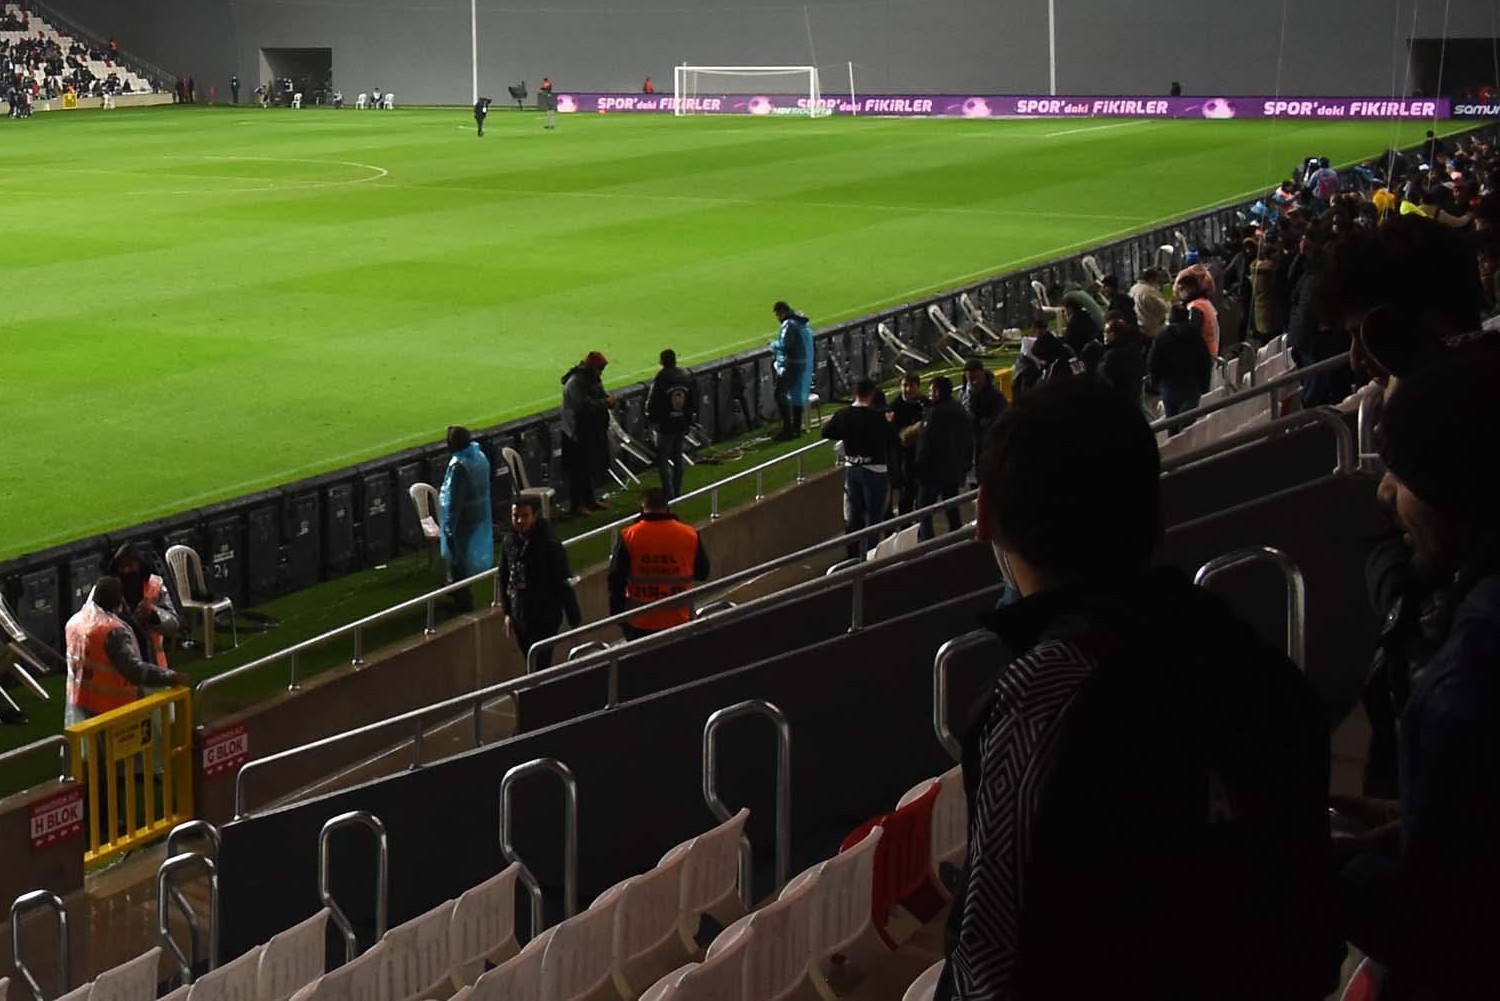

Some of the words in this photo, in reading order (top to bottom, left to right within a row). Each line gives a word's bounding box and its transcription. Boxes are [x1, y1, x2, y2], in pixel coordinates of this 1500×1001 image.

[217, 737, 243, 760] BLOK
[35, 817, 44, 834] H
[47, 805, 78, 830] BLOK
